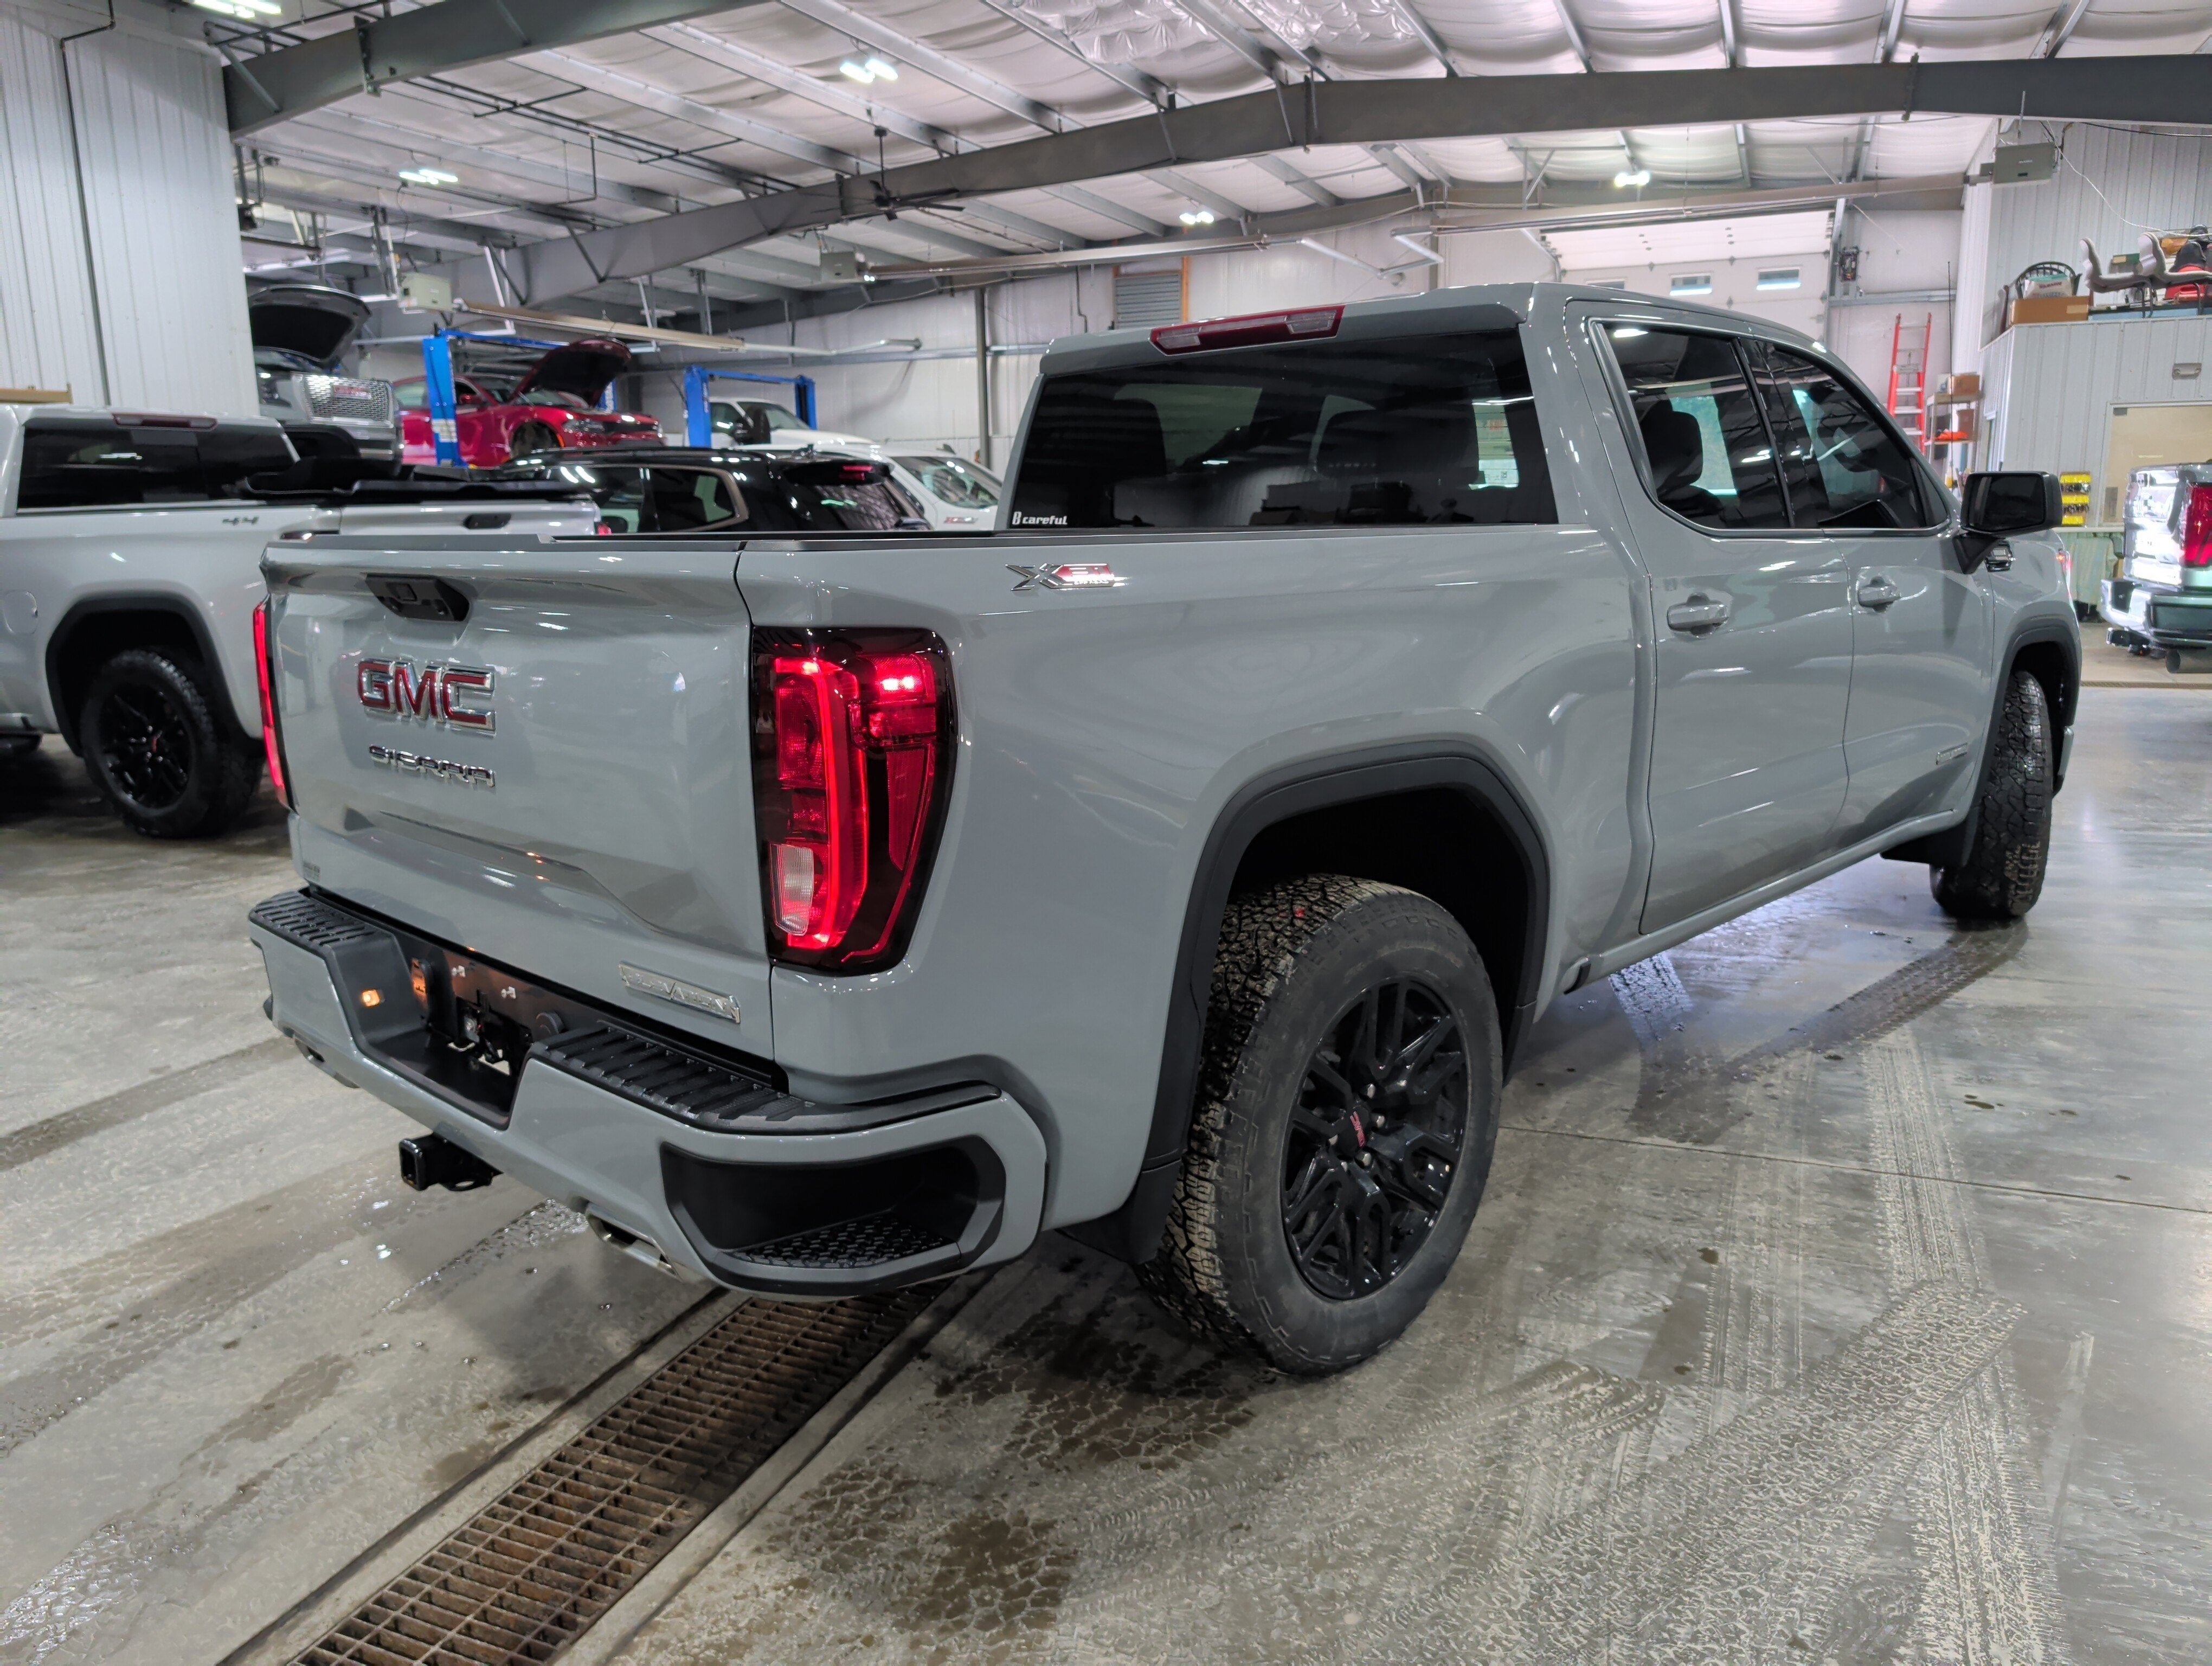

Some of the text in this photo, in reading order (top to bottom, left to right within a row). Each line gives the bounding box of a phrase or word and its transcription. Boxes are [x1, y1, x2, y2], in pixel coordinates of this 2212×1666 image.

[1022, 516, 1068, 525] careful
[357, 657, 496, 732] GMC
[369, 744, 496, 787] SIERRA
[619, 963, 741, 1024] ELEVATION
[1349, 1111, 1366, 1147] GMC
